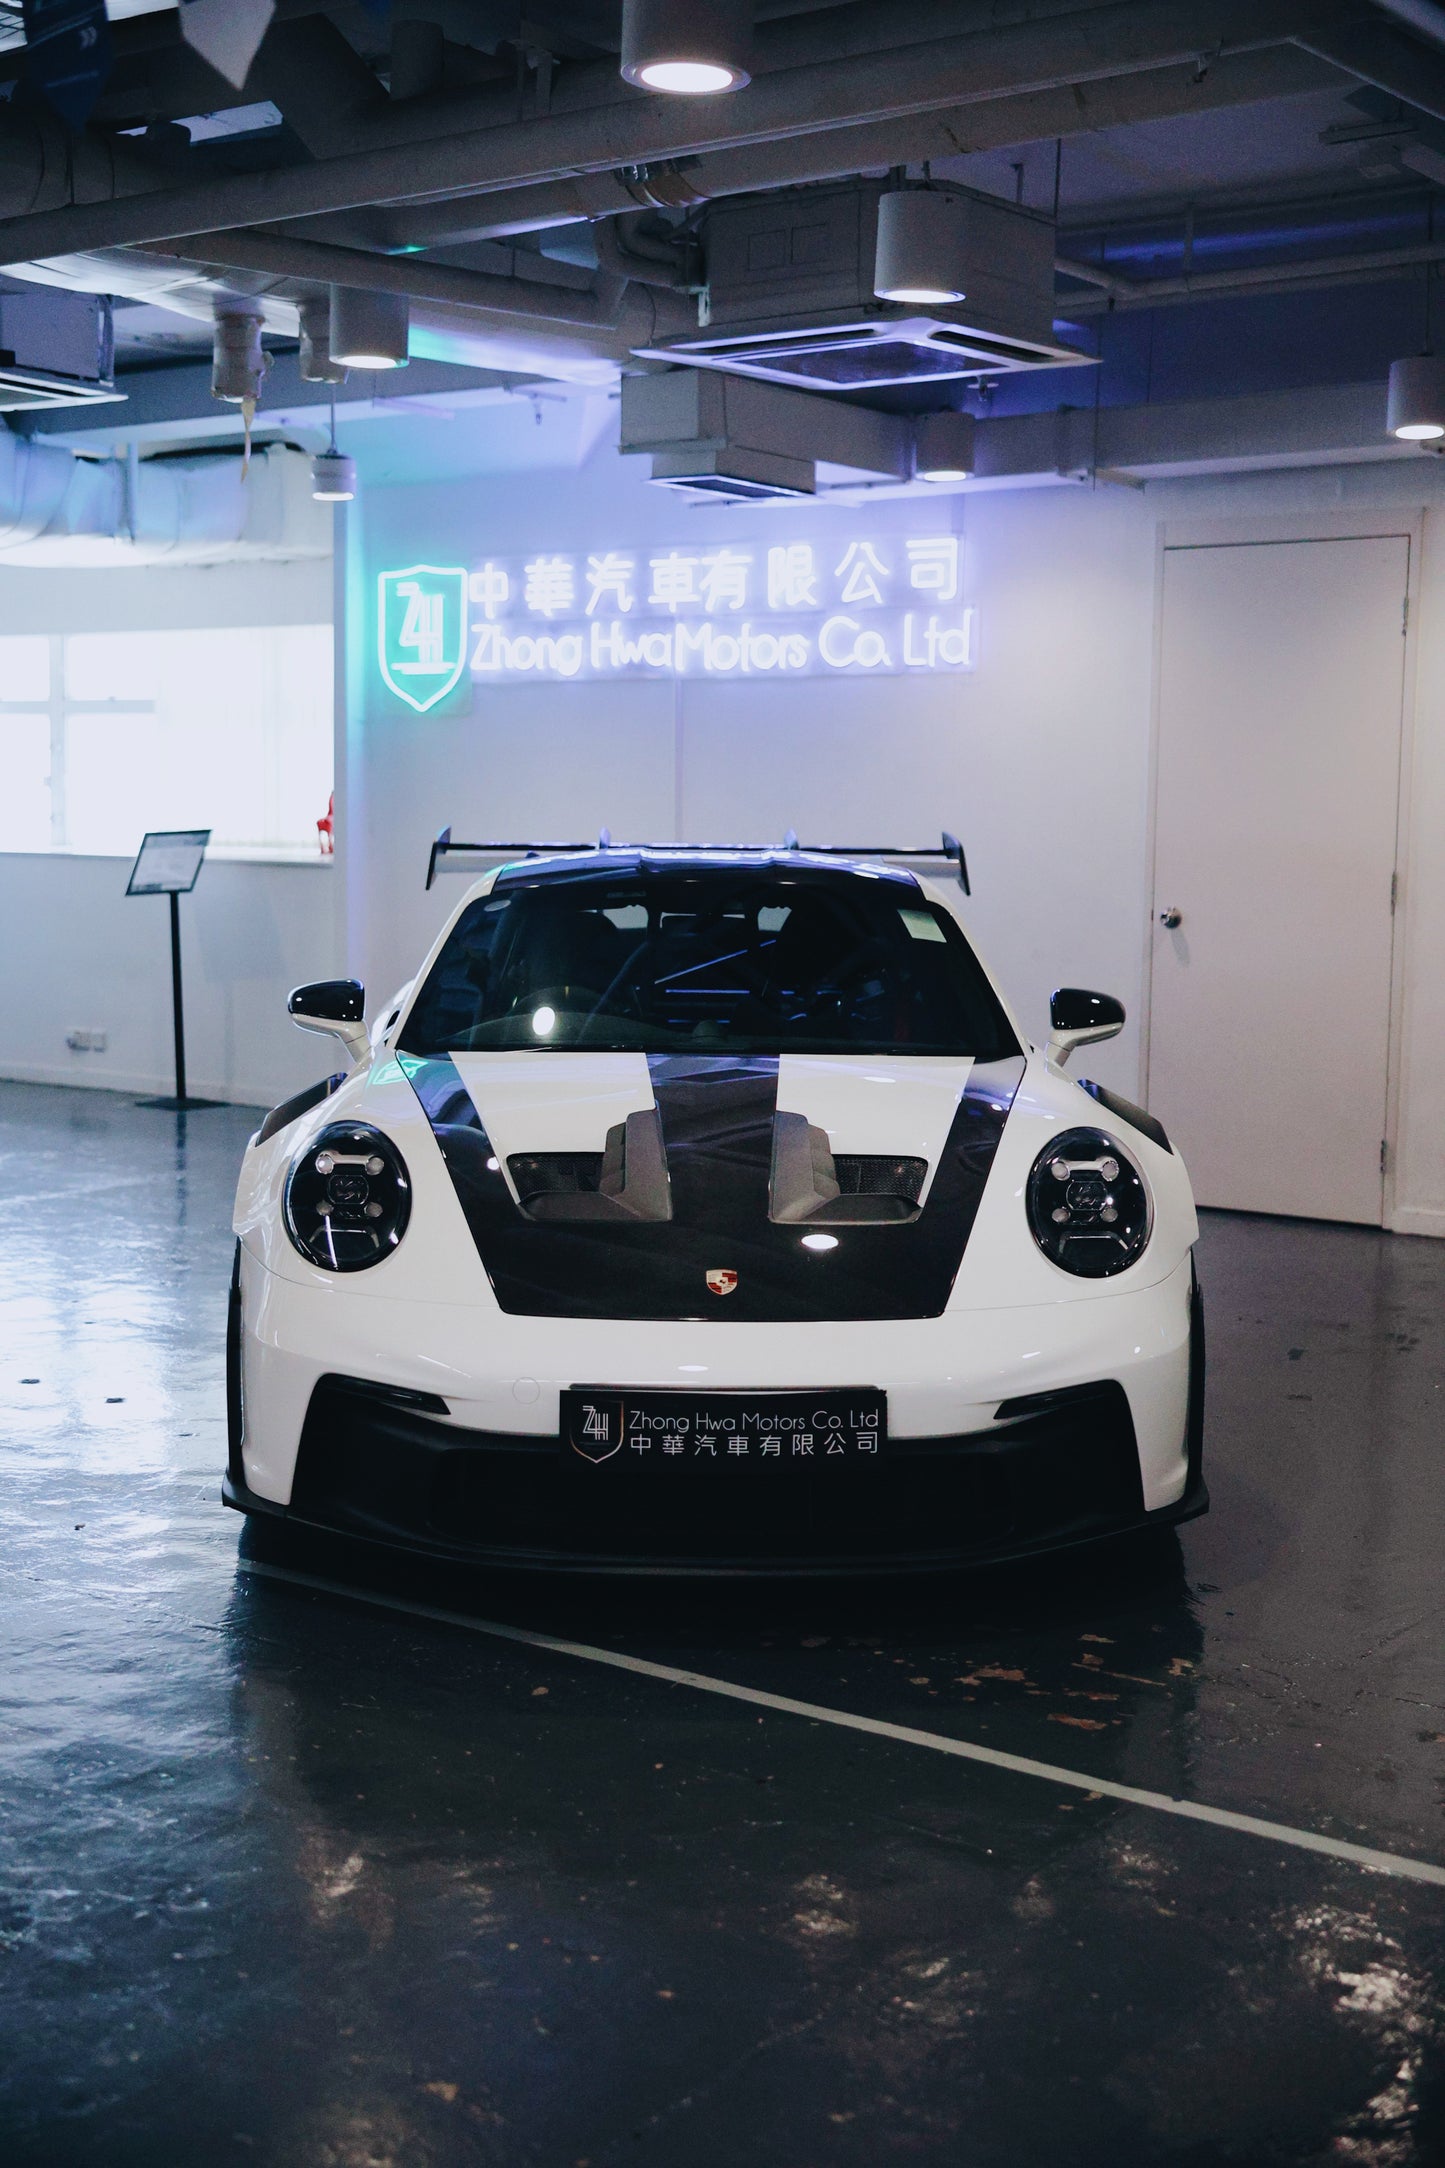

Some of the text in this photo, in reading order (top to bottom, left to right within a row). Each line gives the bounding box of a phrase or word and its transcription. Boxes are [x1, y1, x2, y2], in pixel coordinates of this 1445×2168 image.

[469, 537, 959, 617] 中華汽車有限公司
[469, 623, 584, 676] Zhong
[591, 621, 673, 668] Hwa
[674, 622, 810, 671] Motors
[903, 608, 975, 666] Ltd
[629, 1409, 879, 1432] Zhong Hwa Motors Co. Ltd
[630, 1431, 878, 1457] 中華汽車有限公司
